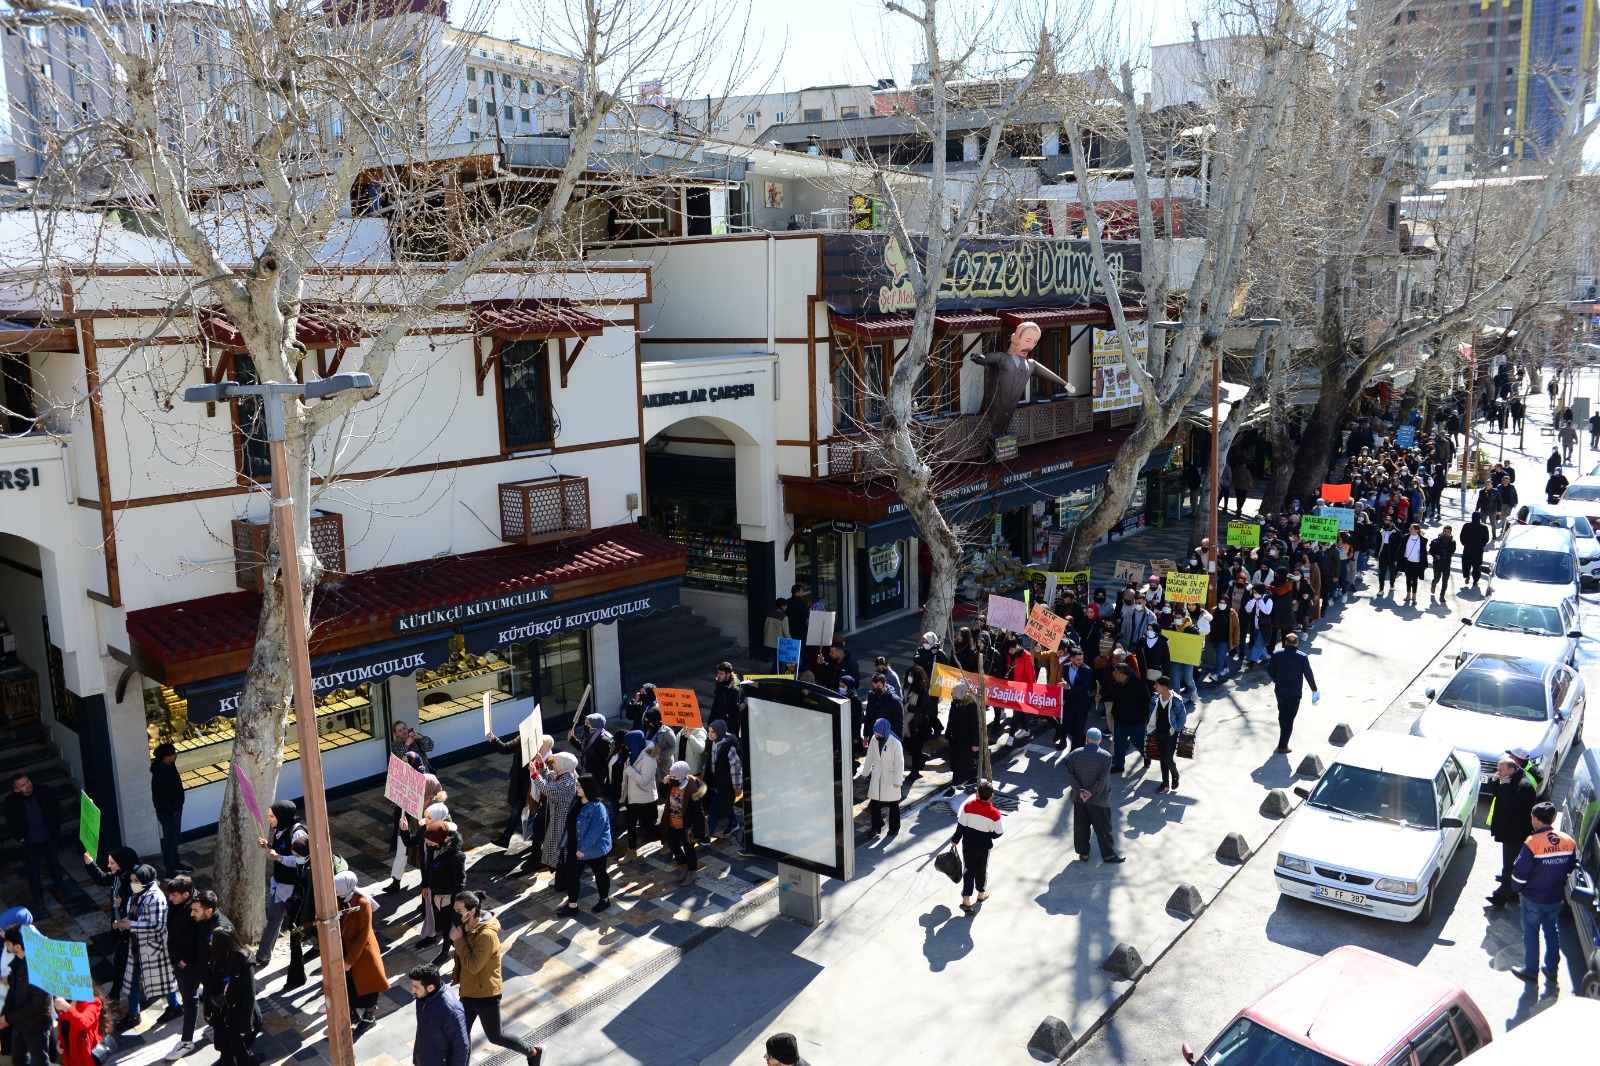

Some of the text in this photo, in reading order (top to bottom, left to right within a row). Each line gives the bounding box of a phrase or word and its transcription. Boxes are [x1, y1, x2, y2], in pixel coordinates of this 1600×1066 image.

[937, 241, 1034, 299] ezzet
[880, 289, 917, 310] Şef Meh
[642, 383, 755, 408] AKIRCILAR ÇARŞISI
[0, 467, 40, 491] RŞI
[399, 589, 549, 630] KÜTÜKÇÜ KUYUMCULUK
[498, 597, 651, 644] KÜTÜKÇÜ KUYUMCULUK
[312, 652, 427, 691] KUYUMCULUK
[992, 686, 1025, 704] Sağlıklı
[1028, 692, 1057, 708] Yaşlan
[1320, 887, 1365, 904] 25 FF 387
